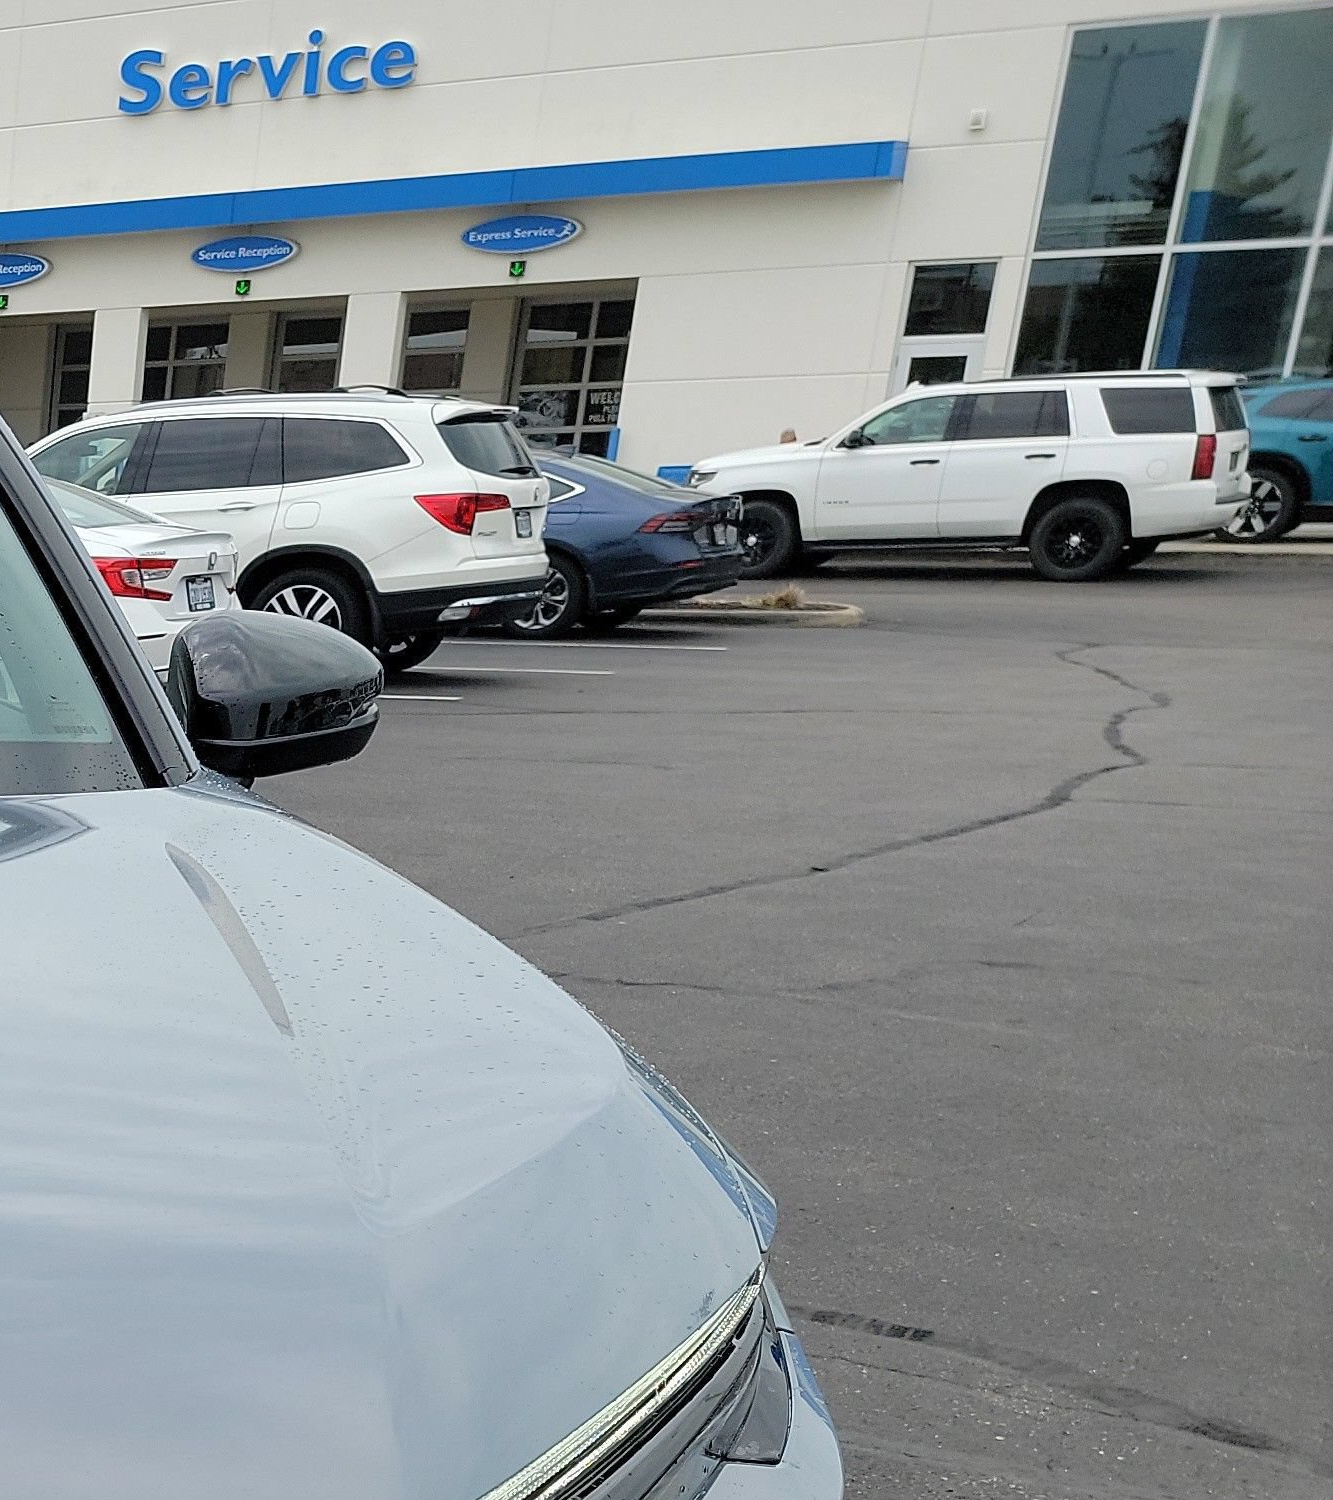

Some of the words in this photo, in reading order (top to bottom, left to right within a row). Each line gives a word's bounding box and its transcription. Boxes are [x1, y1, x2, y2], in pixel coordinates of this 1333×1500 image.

[118, 29, 418, 116] Service
[468, 230, 511, 243] Express
[513, 226, 555, 239] Service
[198, 249, 237, 261] Service
[238, 245, 290, 259] Reception
